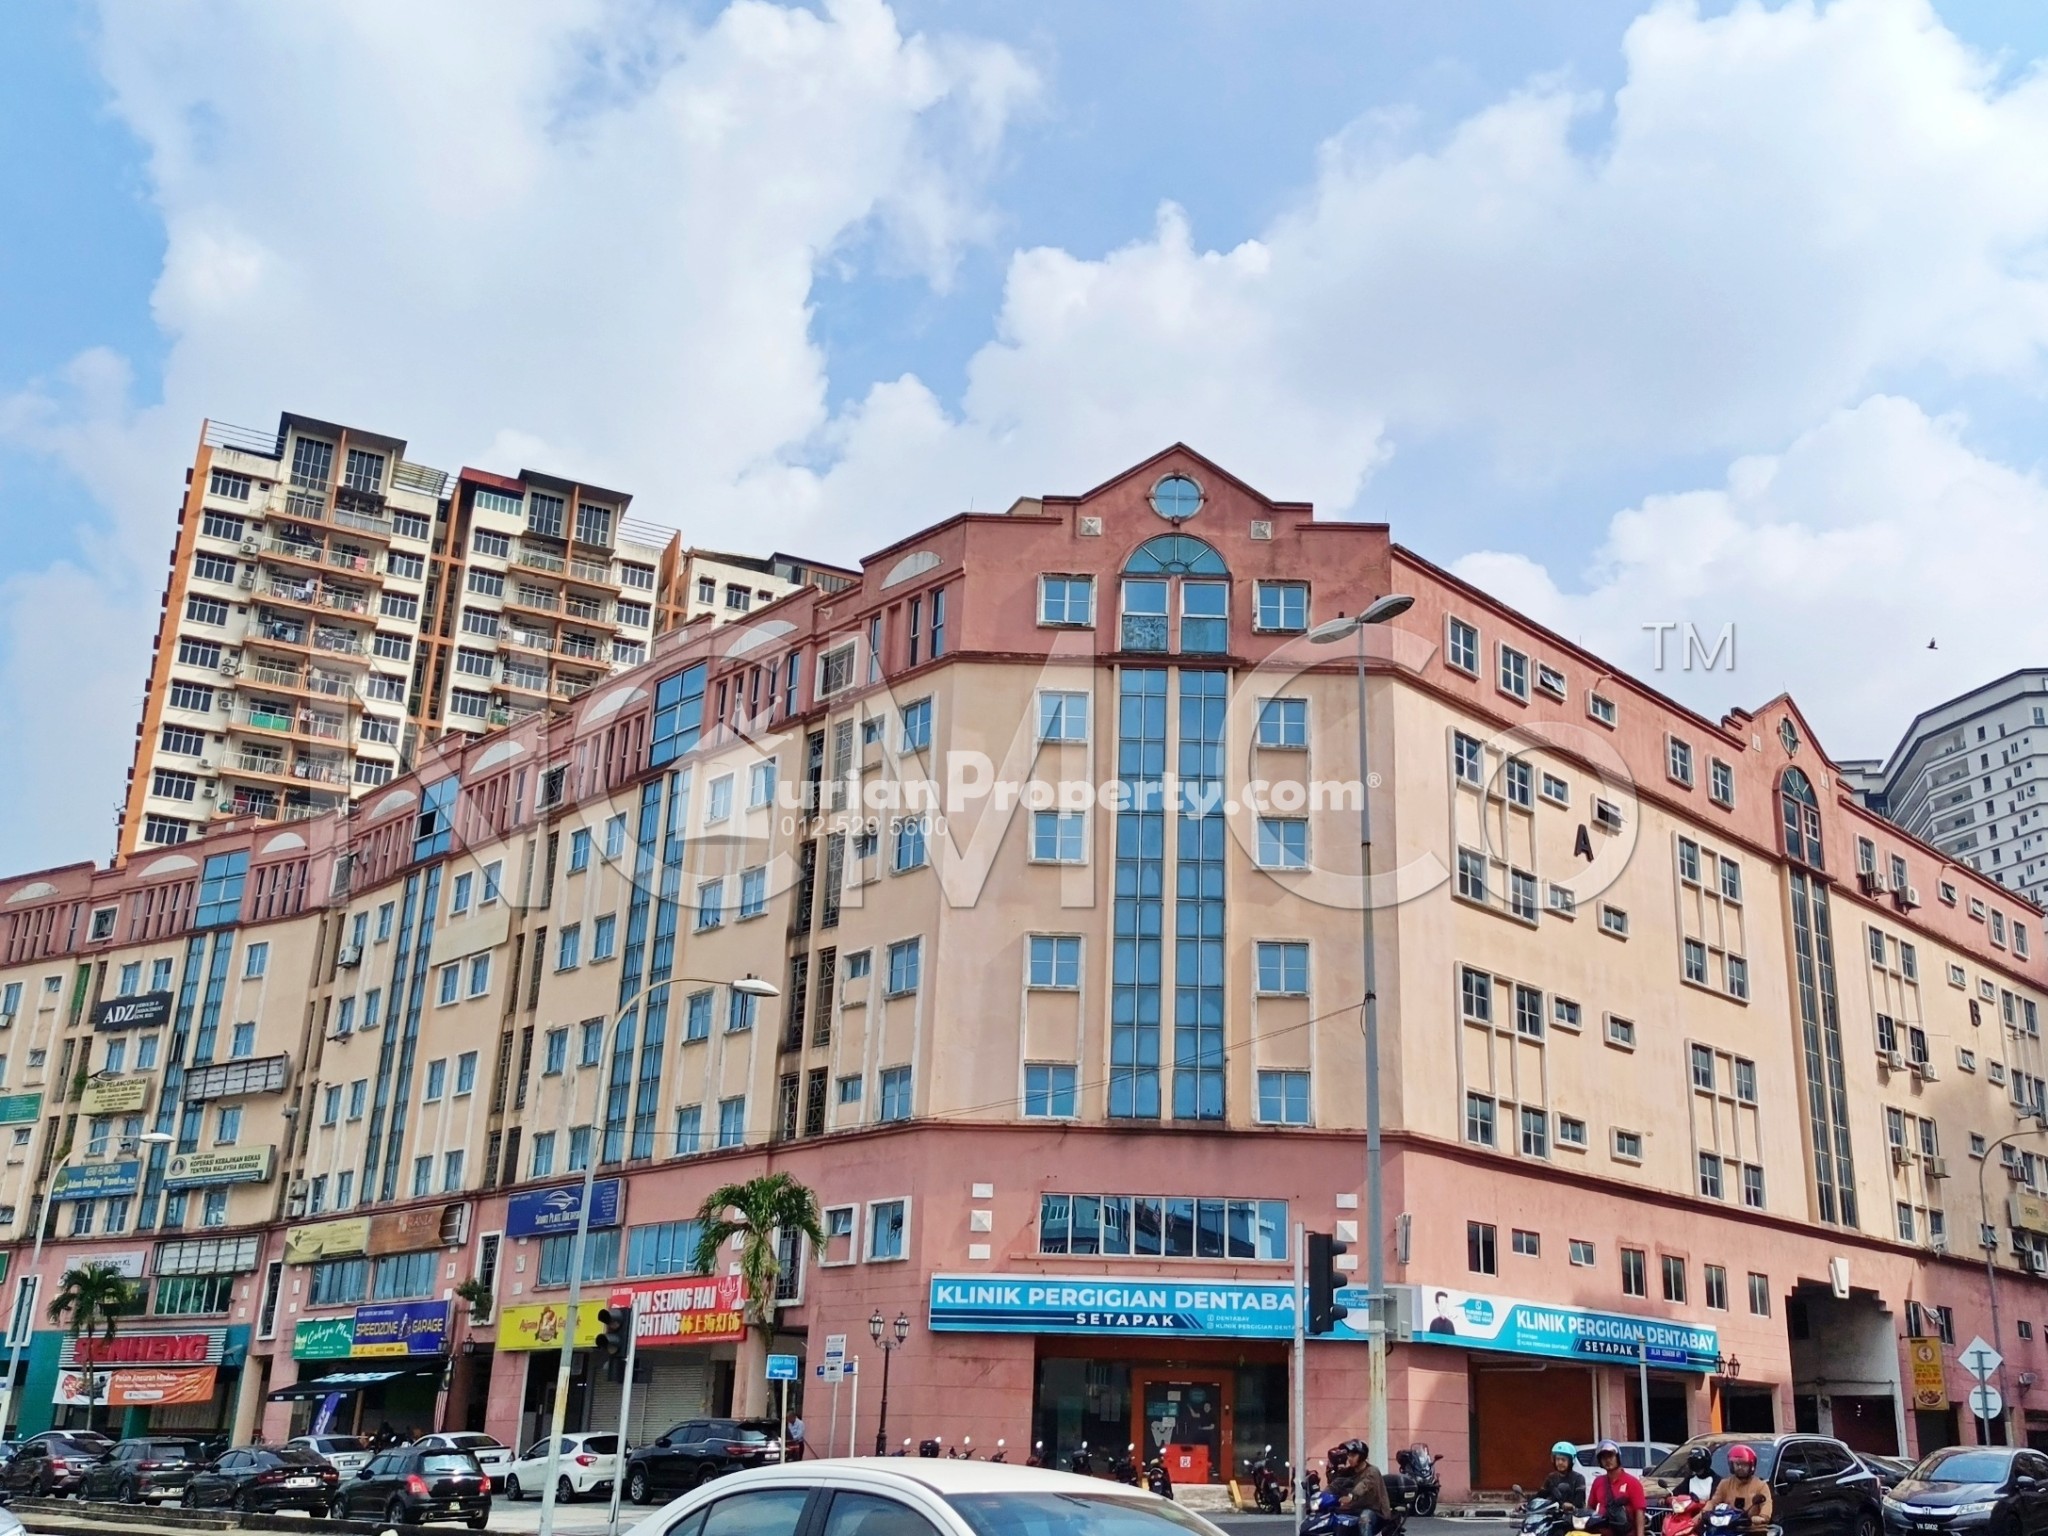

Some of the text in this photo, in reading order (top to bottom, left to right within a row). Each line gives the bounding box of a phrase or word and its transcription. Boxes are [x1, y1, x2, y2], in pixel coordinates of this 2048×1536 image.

[1573, 822, 1594, 862] A
[103, 1004, 136, 1024] ADZ
[1968, 998, 1981, 1027] B
[652, 1287, 693, 1313] SEONG
[693, 1286, 717, 1310] HAI
[937, 1285, 1021, 1305] KLINIK
[1028, 1287, 1167, 1308] PERGIGIAN
[355, 1317, 444, 1337] SPEEDZONE GARAGE
[636, 1312, 682, 1337] GHTING
[1076, 1312, 1175, 1327] SETAPAK
[1516, 1309, 1566, 1333] KLINIK
[1568, 1316, 1643, 1341] PERGIGIAN
[1646, 1326, 1715, 1352] DENTABAY
[73, 1334, 210, 1363] SENHENG
[1584, 1340, 1633, 1356] SETAPAK
